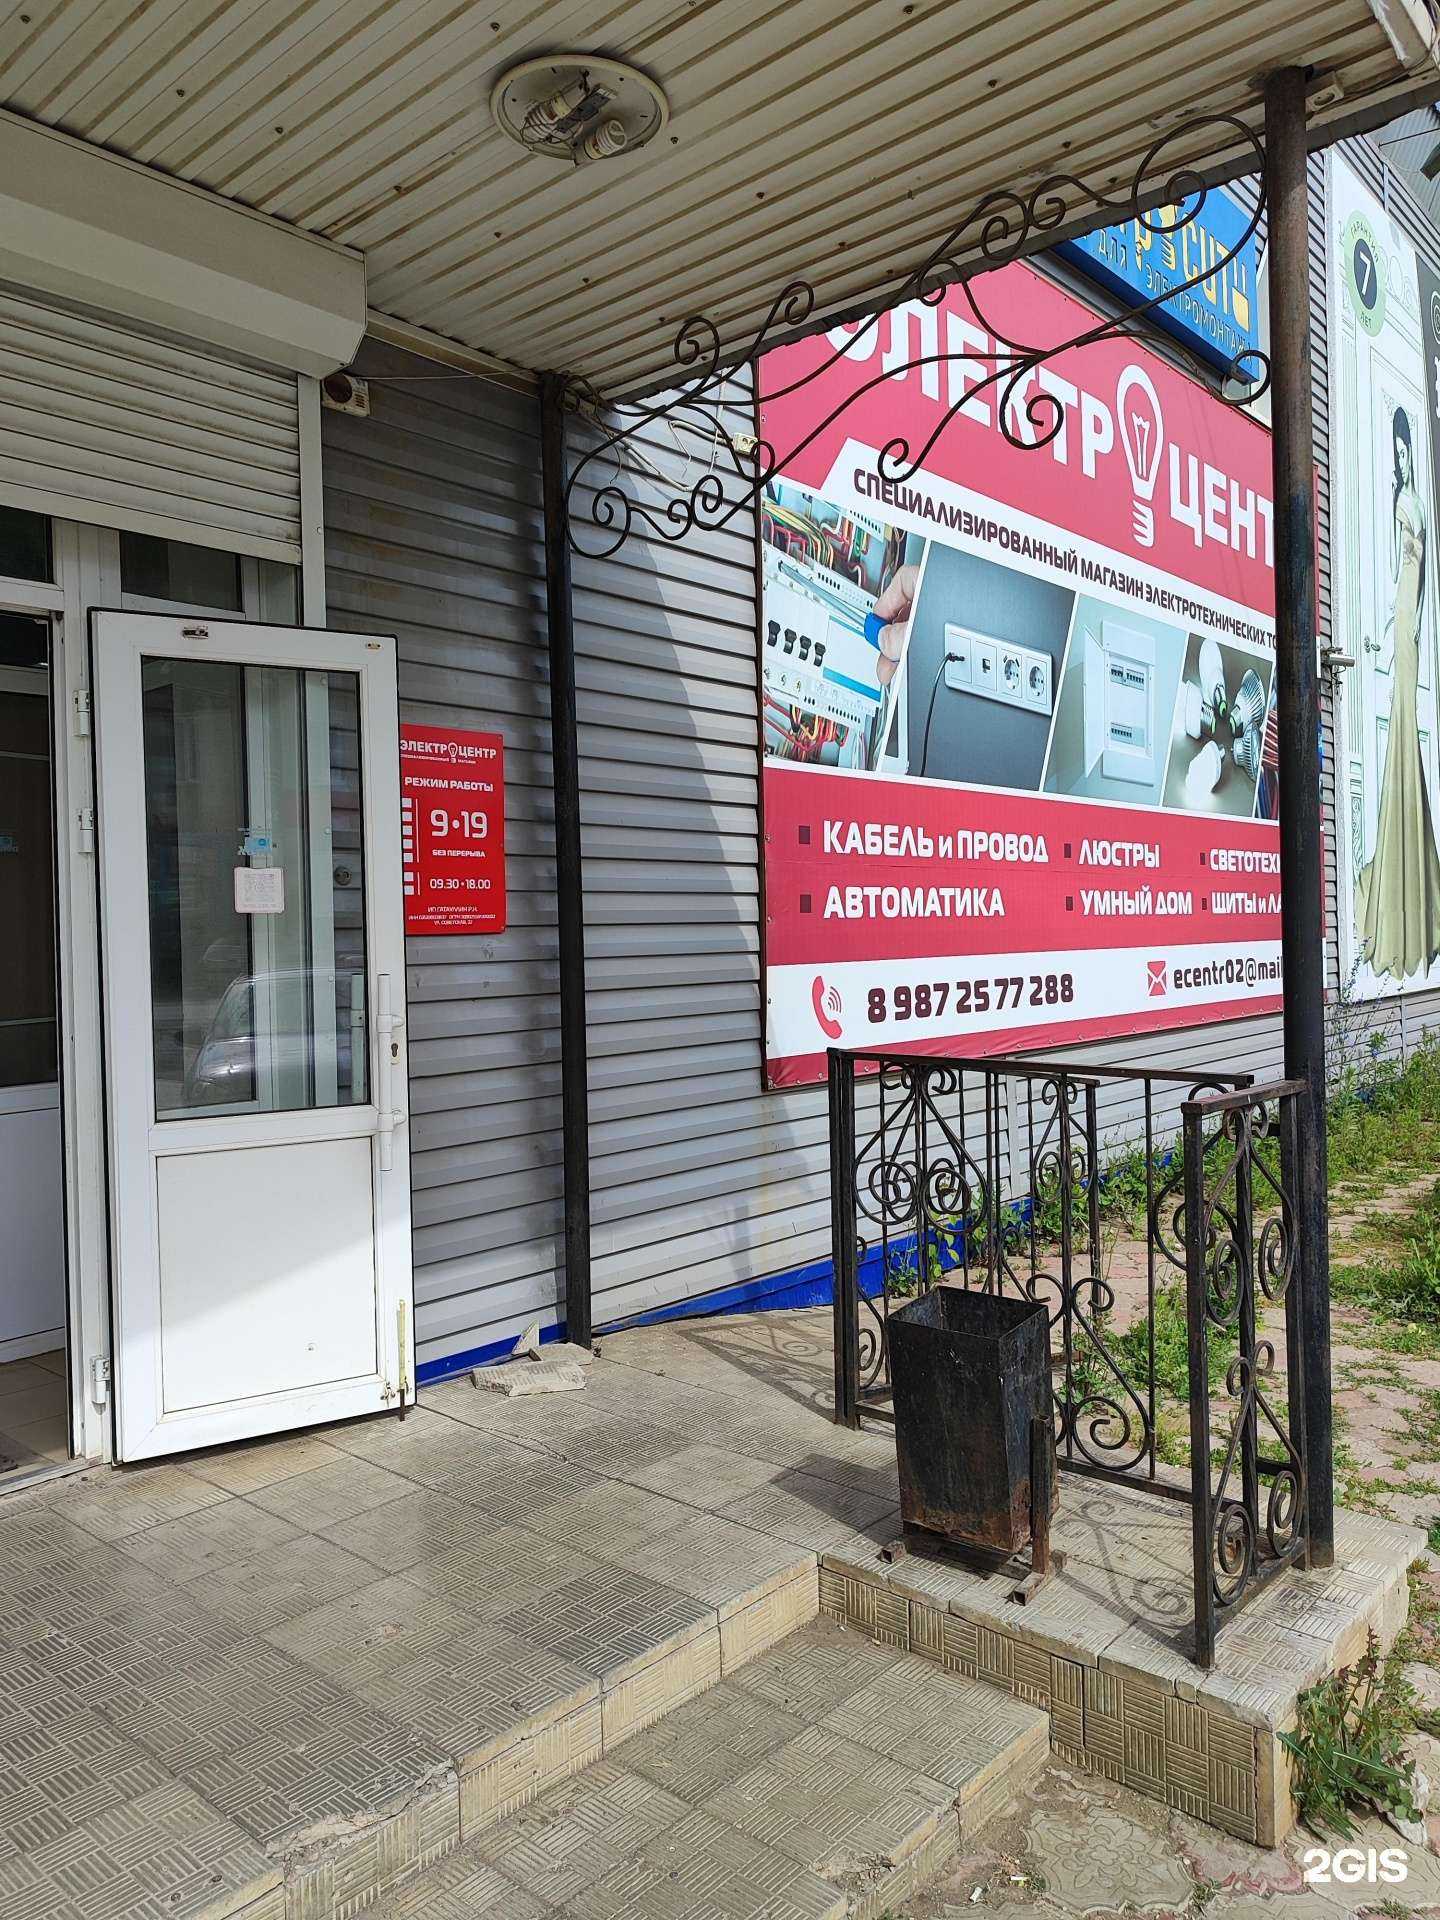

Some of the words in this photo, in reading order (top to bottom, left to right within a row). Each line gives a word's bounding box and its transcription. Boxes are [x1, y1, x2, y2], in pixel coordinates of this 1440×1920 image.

[1099, 229, 1128, 271] ДЛЯ
[1359, 251, 1371, 296] 7
[1360, 311, 1372, 329] ЛЕТ
[853, 468, 1078, 574] СПЕЦИАЛИЗИРОВАННЫЙ
[1081, 556, 1145, 599] МАГАЗИН
[1145, 580, 1266, 646] ЭЛЕКТРОТЕХНИЧЕСКИХ
[404, 776, 449, 789] РЕЖИМ
[450, 780, 493, 792] РАБОТЫ
[432, 849, 447, 857] БЕЗ
[447, 850, 486, 858] ПЕРЕРЫВА
[823, 820, 934, 858] КАБЕЛЬ
[938, 834, 953, 859] и
[957, 830, 1049, 864] ПРОВОД
[1079, 838, 1160, 869] ЛЮСТРЫ
[1210, 848, 1280, 874] СВЕТОТЕХ
[823, 885, 1006, 919] АВТОМАТИКА
[1079, 885, 1153, 915] УМНЫЙ
[1155, 891, 1193, 915] ДОМ
[867, 987, 886, 1024] 8
[894, 982, 950, 1021] 987
[956, 980, 989, 1014] 25
[994, 977, 1024, 1010] 77
[1029, 973, 1074, 1006] 288
